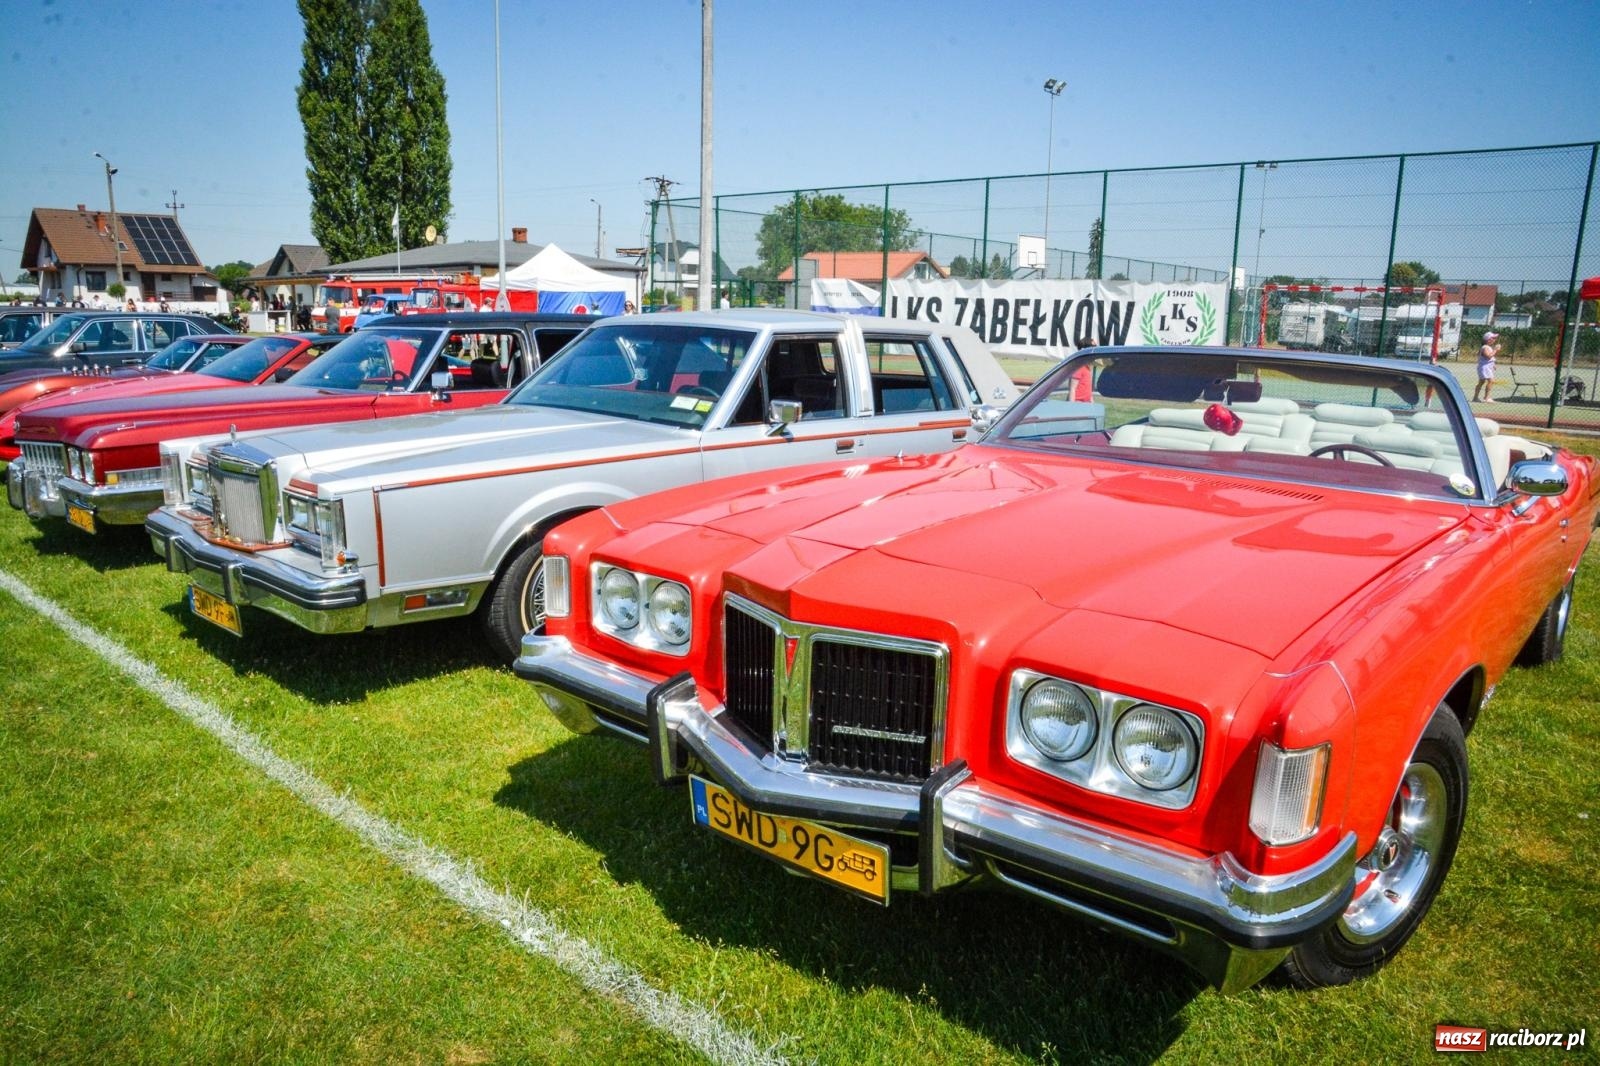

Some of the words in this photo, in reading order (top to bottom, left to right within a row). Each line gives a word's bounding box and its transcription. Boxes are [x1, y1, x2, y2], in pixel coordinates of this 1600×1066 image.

[1166, 289, 1194, 297] 1908
[697, 804, 708, 817] PL
[711, 792, 778, 849] SWD
[791, 825, 835, 872] 9G
